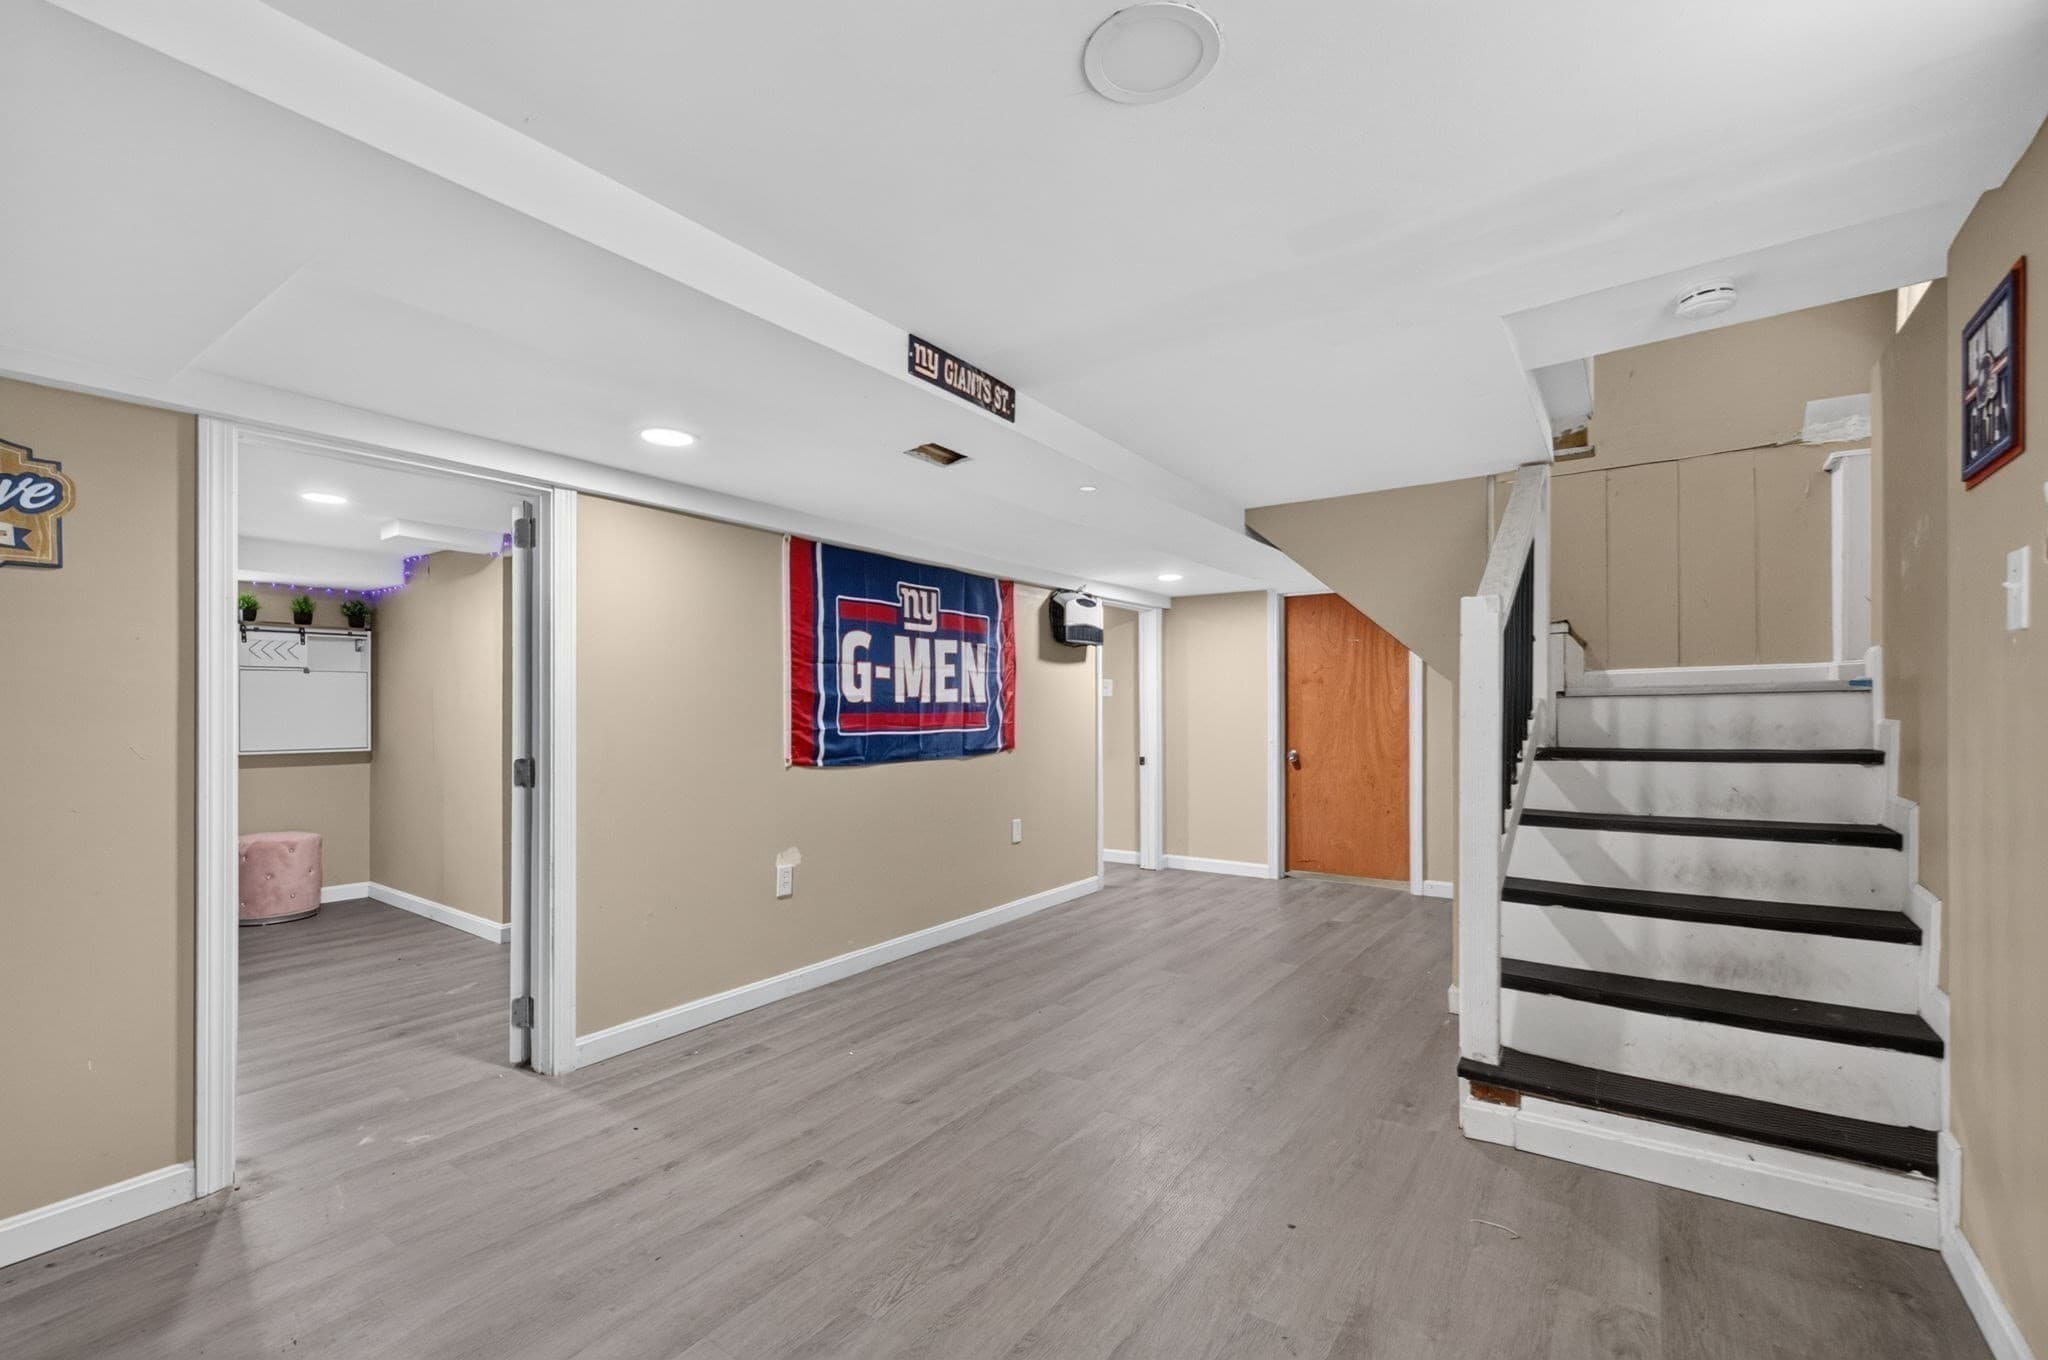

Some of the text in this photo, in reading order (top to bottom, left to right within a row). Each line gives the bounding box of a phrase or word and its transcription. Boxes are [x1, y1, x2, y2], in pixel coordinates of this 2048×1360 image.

[944, 358, 992, 404] GIANTS
[994, 385, 1011, 415] ST.
[841, 630, 987, 704] G-MEN
